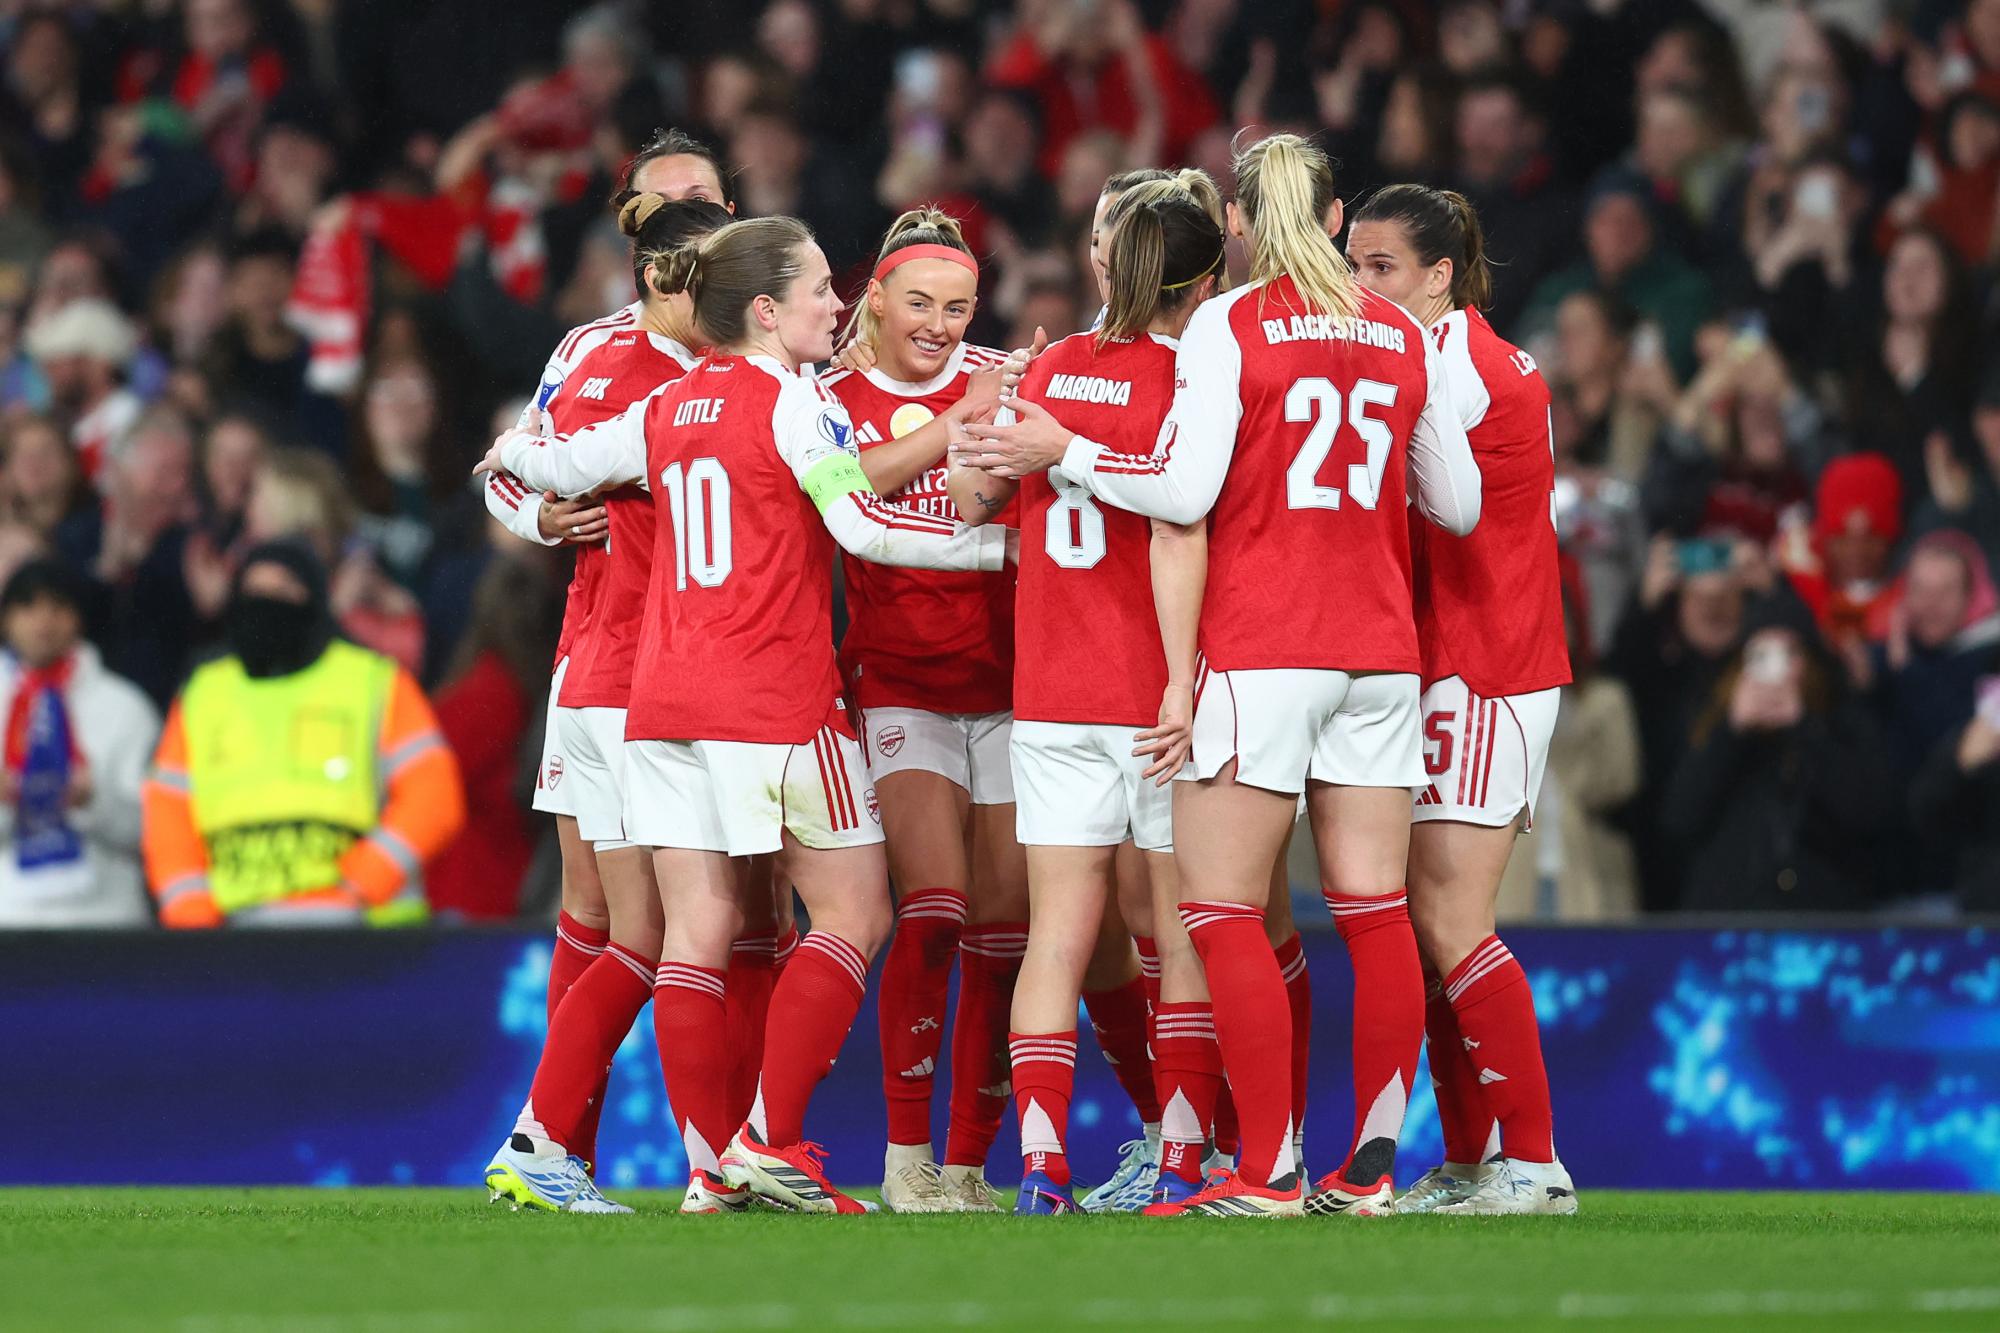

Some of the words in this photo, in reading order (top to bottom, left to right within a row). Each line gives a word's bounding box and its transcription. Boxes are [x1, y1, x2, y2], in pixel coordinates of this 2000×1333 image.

[1262, 314, 1406, 354] BLACKSTENIUS
[575, 377, 613, 400] FOX
[673, 398, 725, 427] LITTLE
[1045, 373, 1132, 406] MARIONA
[1285, 377, 1398, 511] 25
[660, 457, 733, 592] 10
[1045, 464, 1107, 570] 8
[1424, 711, 1456, 776] 5
